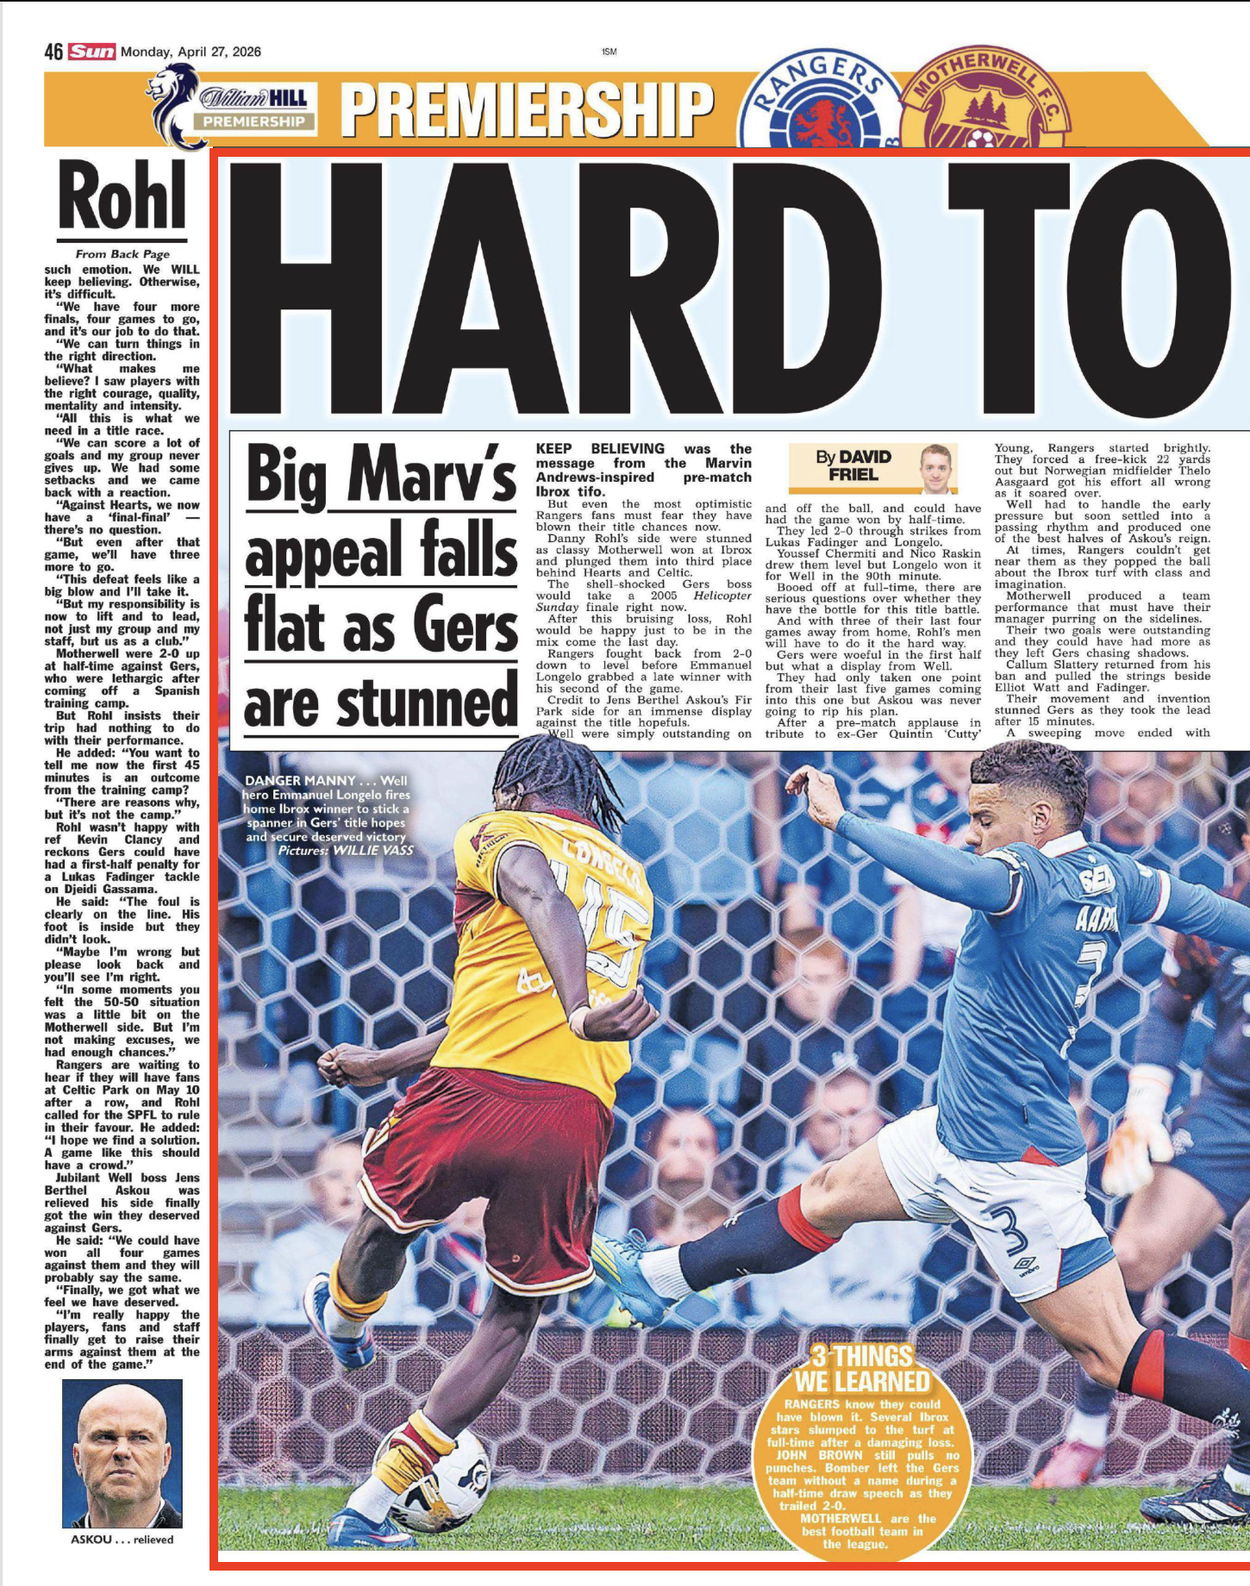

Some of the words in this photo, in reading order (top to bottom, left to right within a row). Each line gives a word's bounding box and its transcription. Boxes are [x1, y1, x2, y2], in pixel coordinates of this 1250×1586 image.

[45, 43, 63, 60] 46
[69, 45, 114, 59] Sun
[121, 47, 172, 59] Monday,
[178, 47, 206, 59] April
[212, 46, 227, 58] 27,
[233, 46, 261, 57] 2026
[913, 52, 1039, 99] MOTHERWELL
[753, 55, 885, 113] RANGERS
[197, 84, 268, 109] William
[267, 89, 307, 106] HILL
[342, 82, 713, 137] PREMIERSHIP
[204, 116, 305, 127] PREMIERSHIP
[60, 159, 185, 229] Rohl
[76, 250, 106, 258] From
[111, 250, 138, 258] Back
[144, 250, 170, 261] Page
[45, 265, 71, 274] such
[83, 265, 131, 274] emotion.
[143, 265, 160, 274] We
[171, 265, 200, 274] WILL
[68, 289, 115, 299] difficult.
[230, 163, 882, 414] HARD
[948, 159, 1231, 418] TO
[537, 443, 572, 454] KEEP
[592, 443, 664, 454] BELIEVING
[684, 446, 710, 454] was
[730, 443, 752, 454] the
[995, 444, 1033, 454] Young,
[1049, 444, 1094, 454] Rangers
[1110, 443, 1148, 452] started
[1164, 443, 1210, 454] brightly.
[537, 460, 594, 471] message
[614, 457, 645, 468] from
[665, 457, 686, 468] the
[706, 457, 751, 468] Marvin
[817, 450, 836, 466] By
[840, 450, 892, 463] DAVID
[249, 443, 326, 514] Big
[536, 472, 654, 485] Andrews-inspired
[684, 472, 751, 485] pre-match
[830, 468, 879, 481] FRIEL
[537, 486, 570, 497] Ibrox
[578, 486, 605, 497] tifo.
[548, 500, 567, 508] But
[622, 499, 639, 508] the
[696, 500, 751, 510] optimistic
[246, 519, 402, 588] appeal
[421, 518, 517, 576] falls
[244, 593, 324, 652] flat
[344, 613, 395, 652] as
[414, 593, 518, 652] Gers
[244, 688, 318, 727] are
[337, 669, 517, 727] stunned
[247, 776, 301, 786] DANGER
[305, 776, 356, 786] MANNY
[381, 776, 406, 786] Well
[243, 790, 268, 799] hero
[274, 790, 332, 799] Emmanuel
[338, 790, 381, 801] Longelo
[386, 790, 410, 799] fires
[244, 804, 275, 813] home
[280, 804, 308, 813] Ibrox
[314, 804, 352, 813] winner
[374, 804, 399, 813] stick
[247, 820, 293, 830] spanner
[298, 818, 307, 827] in
[345, 818, 368, 828] title
[372, 817, 406, 830] hopes
[247, 832, 266, 840] and
[312, 832, 362, 841] deserved
[367, 832, 405, 843] victory
[279, 846, 328, 855] Pictures:
[334, 846, 379, 855] WILLIE
[384, 846, 414, 855] VASS
[989, 1205, 1029, 1258] 3
[813, 1346, 825, 1366] 3
[834, 1346, 912, 1366] THINGS
[45, 1359, 65, 1369] end
[71, 1359, 83, 1369] of
[88, 1359, 106, 1369] the
[795, 1372, 827, 1391] WE
[836, 1372, 929, 1391] LEARNED
[786, 1400, 839, 1408] RANGERS
[71, 1535, 111, 1544] ASKOU
[134, 1535, 173, 1544] relieved
